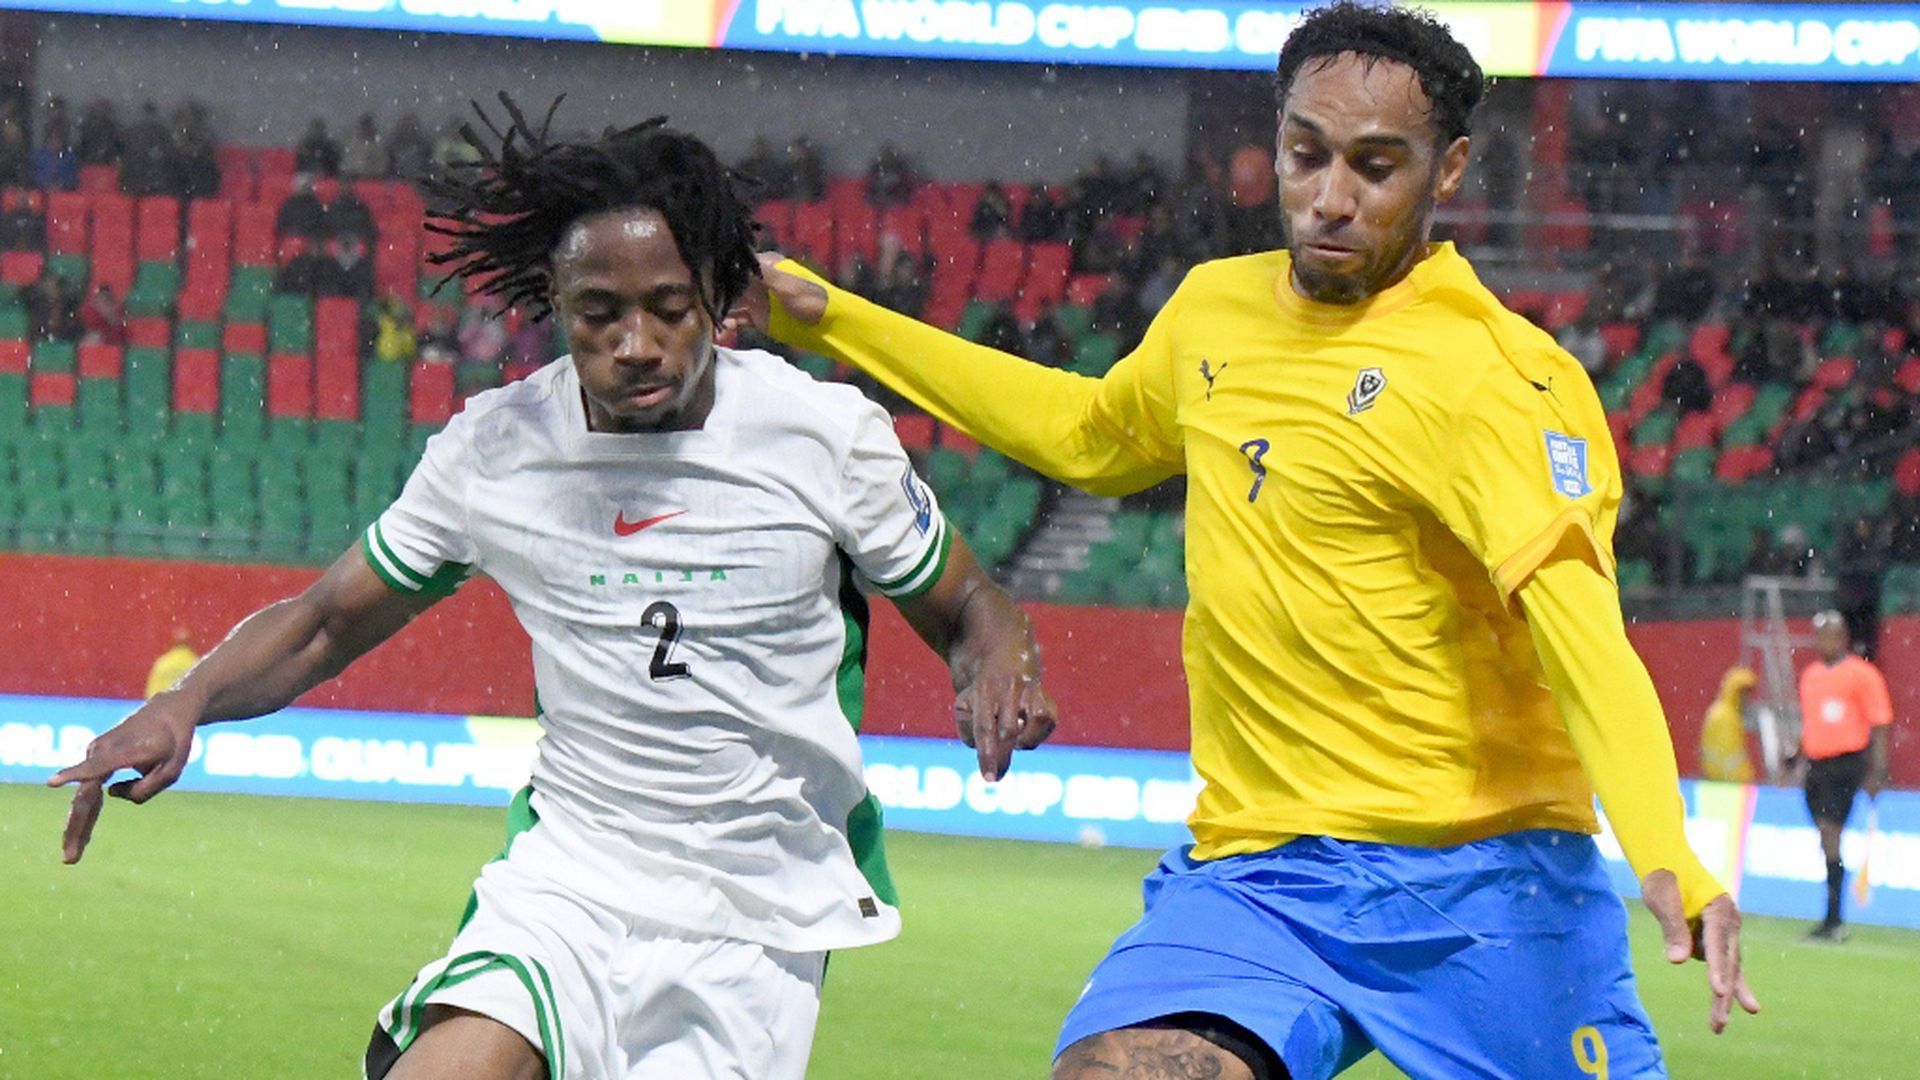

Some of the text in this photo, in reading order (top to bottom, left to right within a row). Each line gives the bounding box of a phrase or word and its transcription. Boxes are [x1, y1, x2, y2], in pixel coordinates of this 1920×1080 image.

[757, 0, 860, 37] FIFA
[863, 0, 1035, 45] WORLD
[1037, 4, 1135, 48] CUP
[1576, 18, 1919, 65] FIFA WORLD CUP
[1240, 439, 1270, 502] 9
[589, 567, 727, 586] NAIJA
[640, 600, 692, 682] 2
[966, 770, 1063, 816] CUP
[1571, 1025, 1609, 1080] 9
